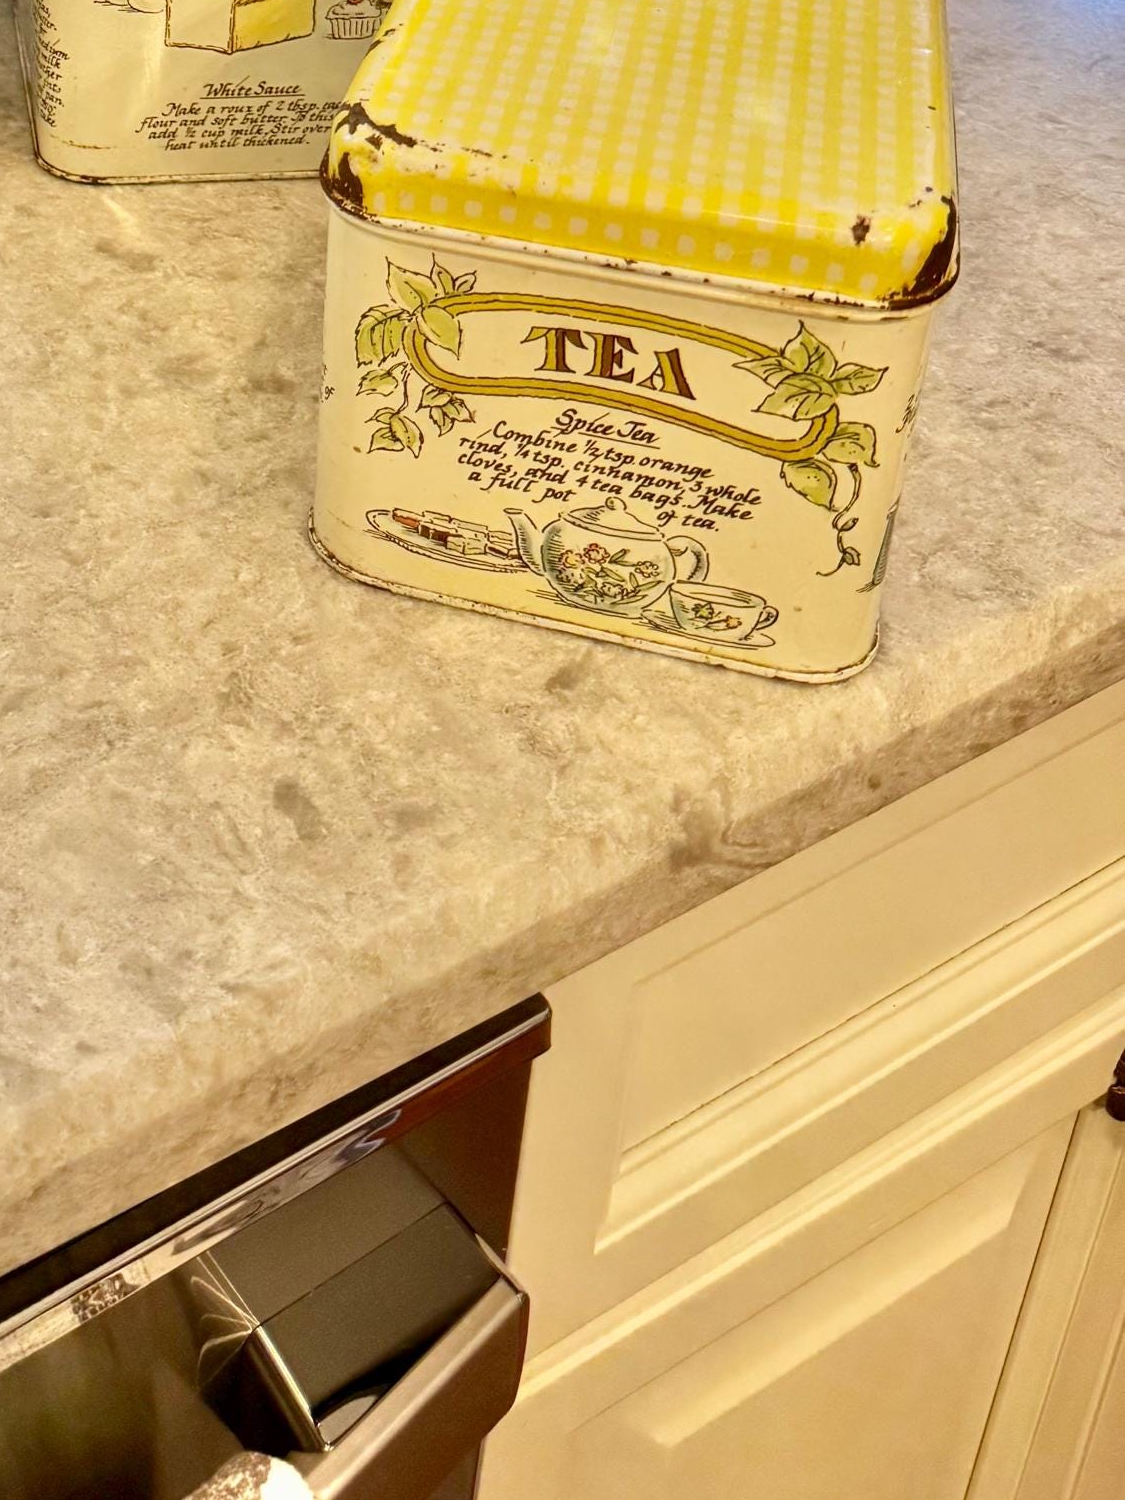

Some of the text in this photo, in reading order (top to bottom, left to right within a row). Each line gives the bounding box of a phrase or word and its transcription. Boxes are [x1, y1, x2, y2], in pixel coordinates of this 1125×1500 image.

[203, 79, 302, 97] White Sauce
[135, 117, 177, 133] flour
[179, 115, 208, 127] and
[211, 114, 238, 129] soft
[309, 110, 334, 122] this
[162, 102, 201, 117] Make
[206, 106, 215, 114] a
[221, 105, 254, 114] roux
[257, 100, 272, 116] of
[276, 101, 285, 111] 2
[148, 123, 332, 141] add cup Stir over
[165, 139, 196, 151] heat
[200, 137, 240, 149] until
[520, 325, 695, 400] TEA
[555, 408, 660, 444] Spice Tea
[493, 420, 577, 453] Combine
[638, 456, 715, 482] orange
[458, 451, 518, 477] cloves,
[525, 467, 570, 485] and
[576, 475, 589, 488] 4
[590, 478, 623, 495] tea
[687, 494, 754, 520] Make
[533, 450, 565, 470] tsp.
[689, 480, 704, 492] 3
[705, 484, 762, 505] whole
[468, 471, 719, 532] a full pot of tea.
